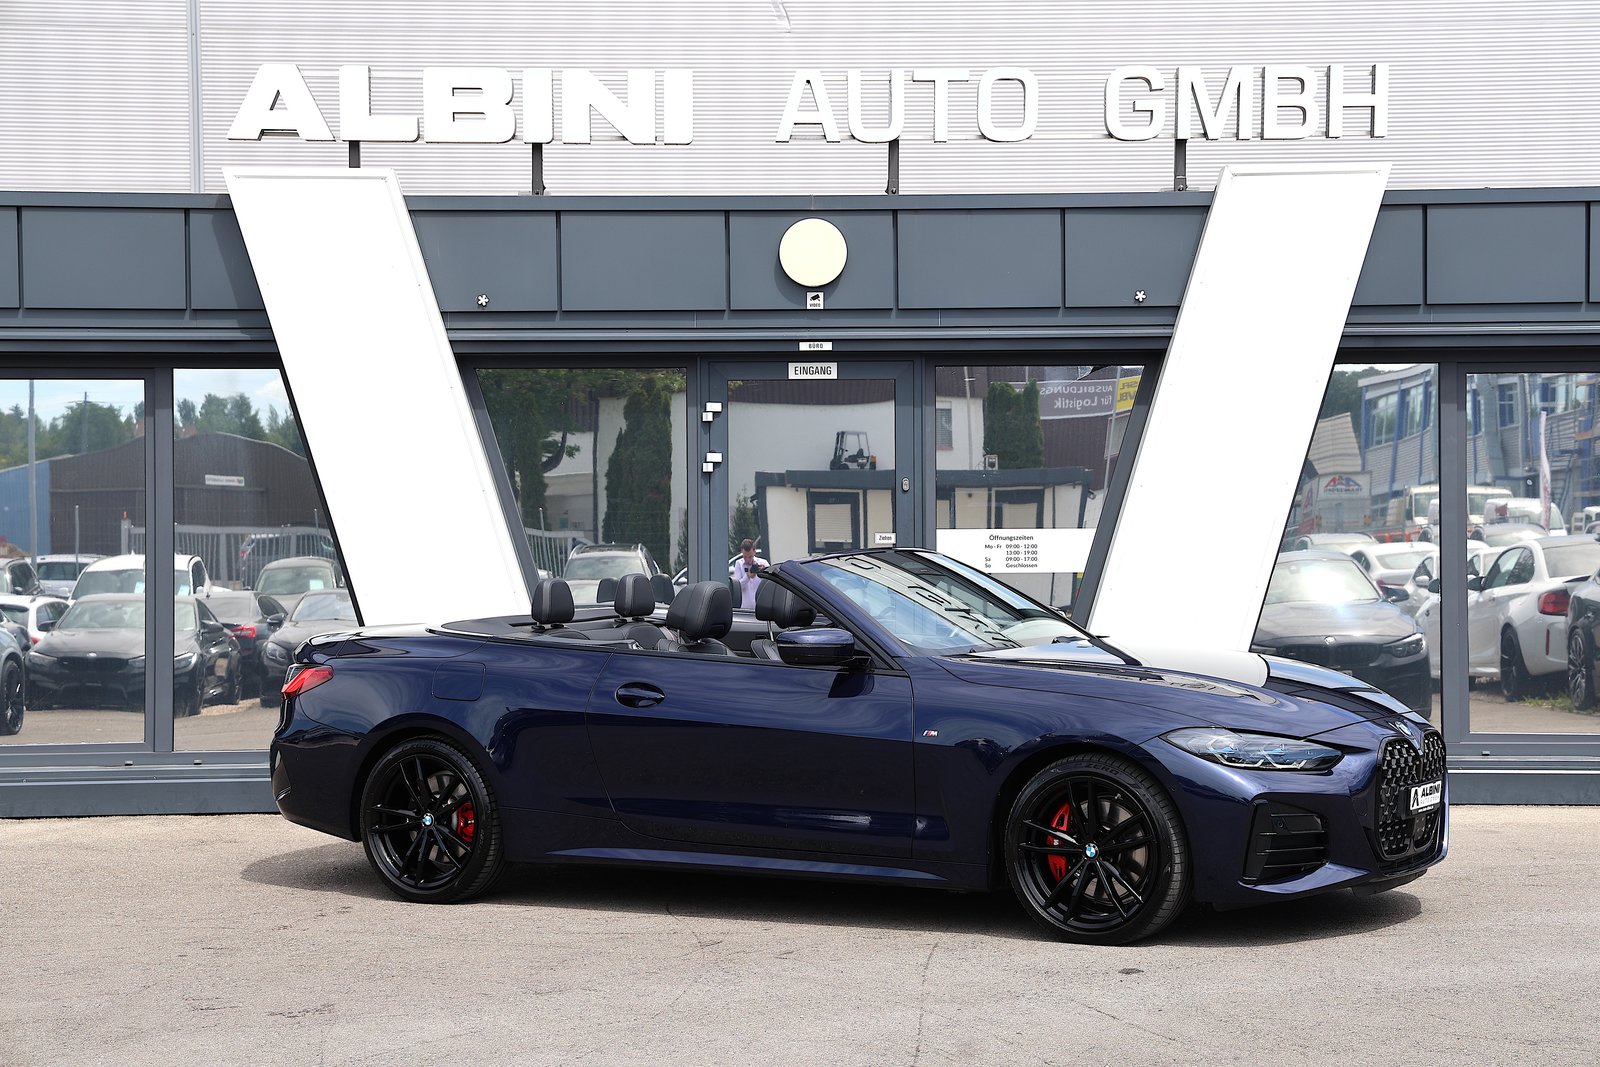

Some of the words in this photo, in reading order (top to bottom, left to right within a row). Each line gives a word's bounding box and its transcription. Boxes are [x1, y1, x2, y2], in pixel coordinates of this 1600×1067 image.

[227, 63, 694, 145] ALBINI
[775, 67, 1039, 144] AUTO
[1104, 63, 1390, 141] GMBH
[794, 366, 832, 375] EINGANG
